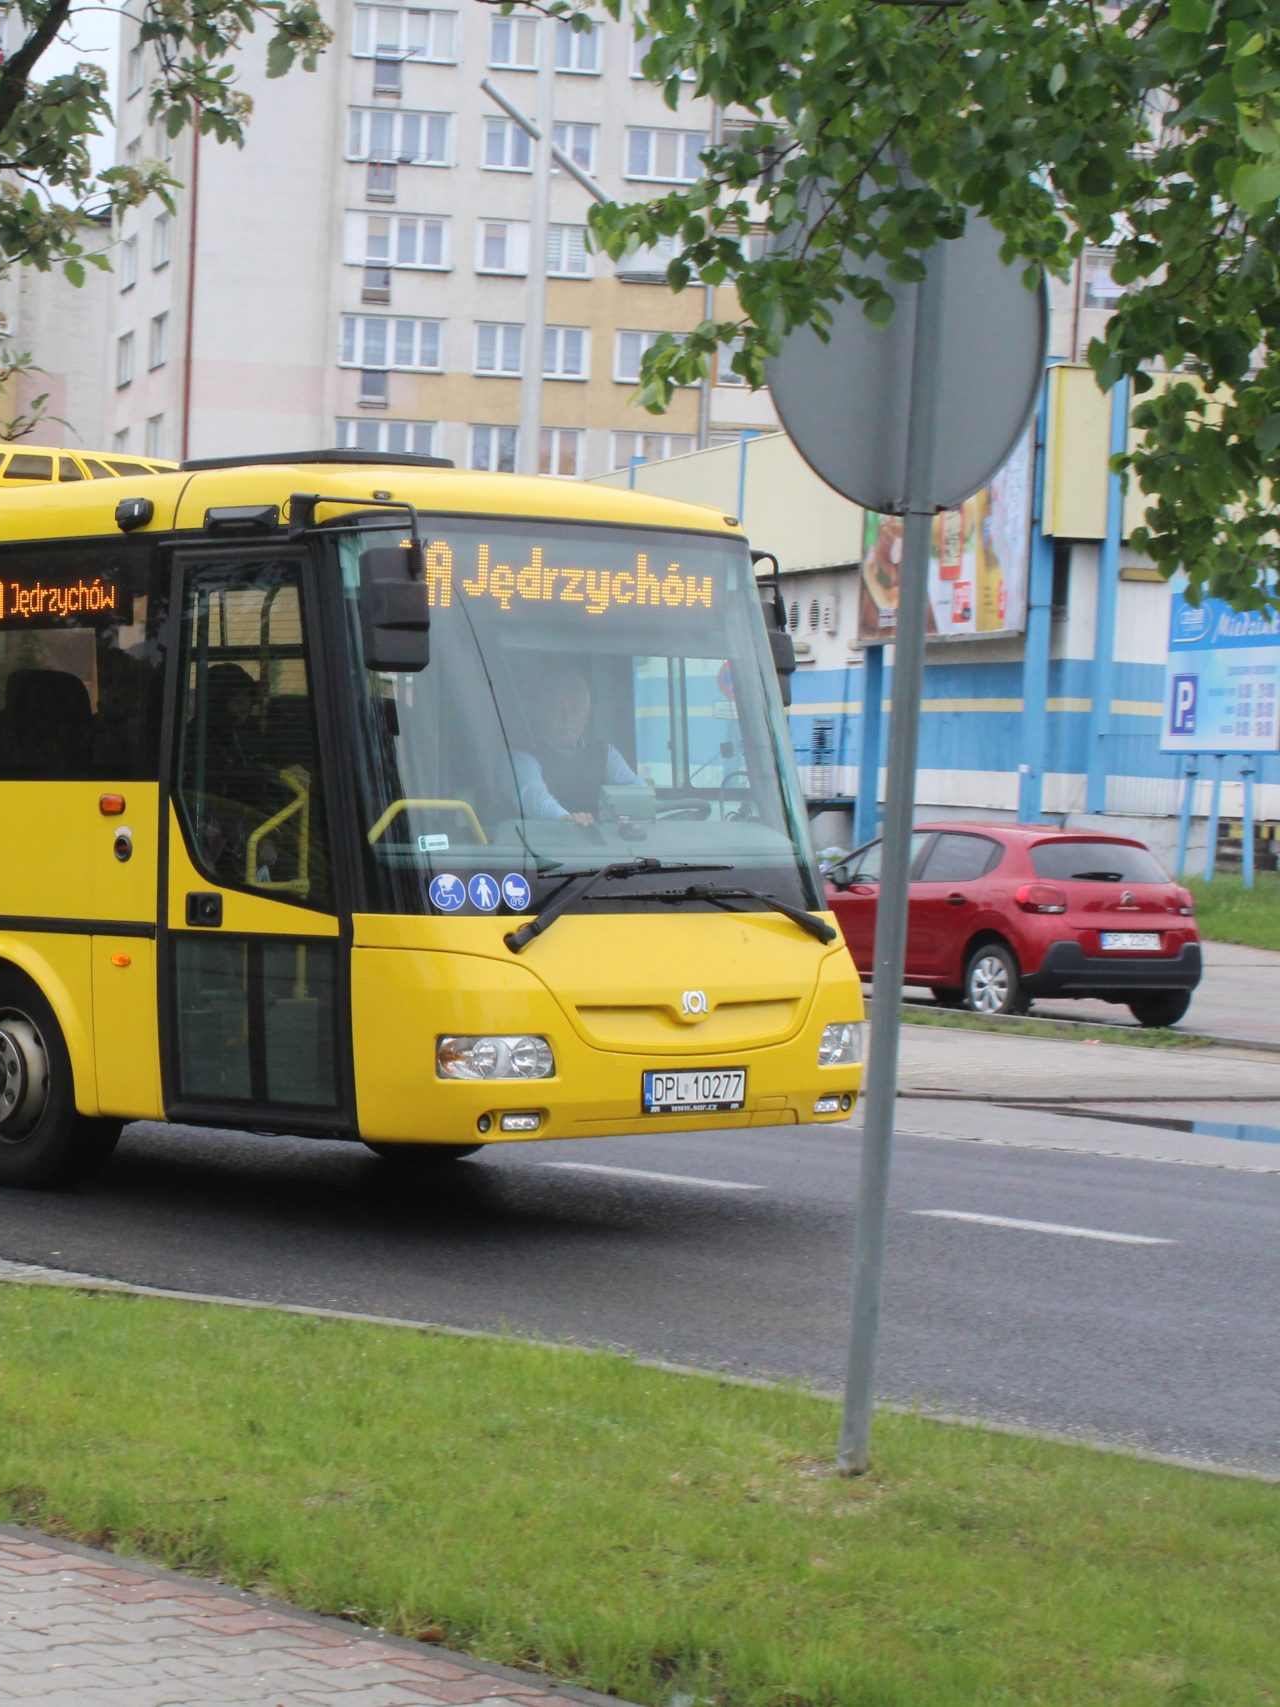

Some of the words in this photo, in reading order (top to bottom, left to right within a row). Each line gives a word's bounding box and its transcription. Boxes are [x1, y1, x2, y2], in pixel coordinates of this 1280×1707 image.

[10, 578, 116, 617] Jędrzychów
[462, 544, 713, 614] Jędrzychów
[1176, 680, 1194, 728] P
[654, 1077, 685, 1102] DPL
[693, 1074, 742, 1099] 10277
